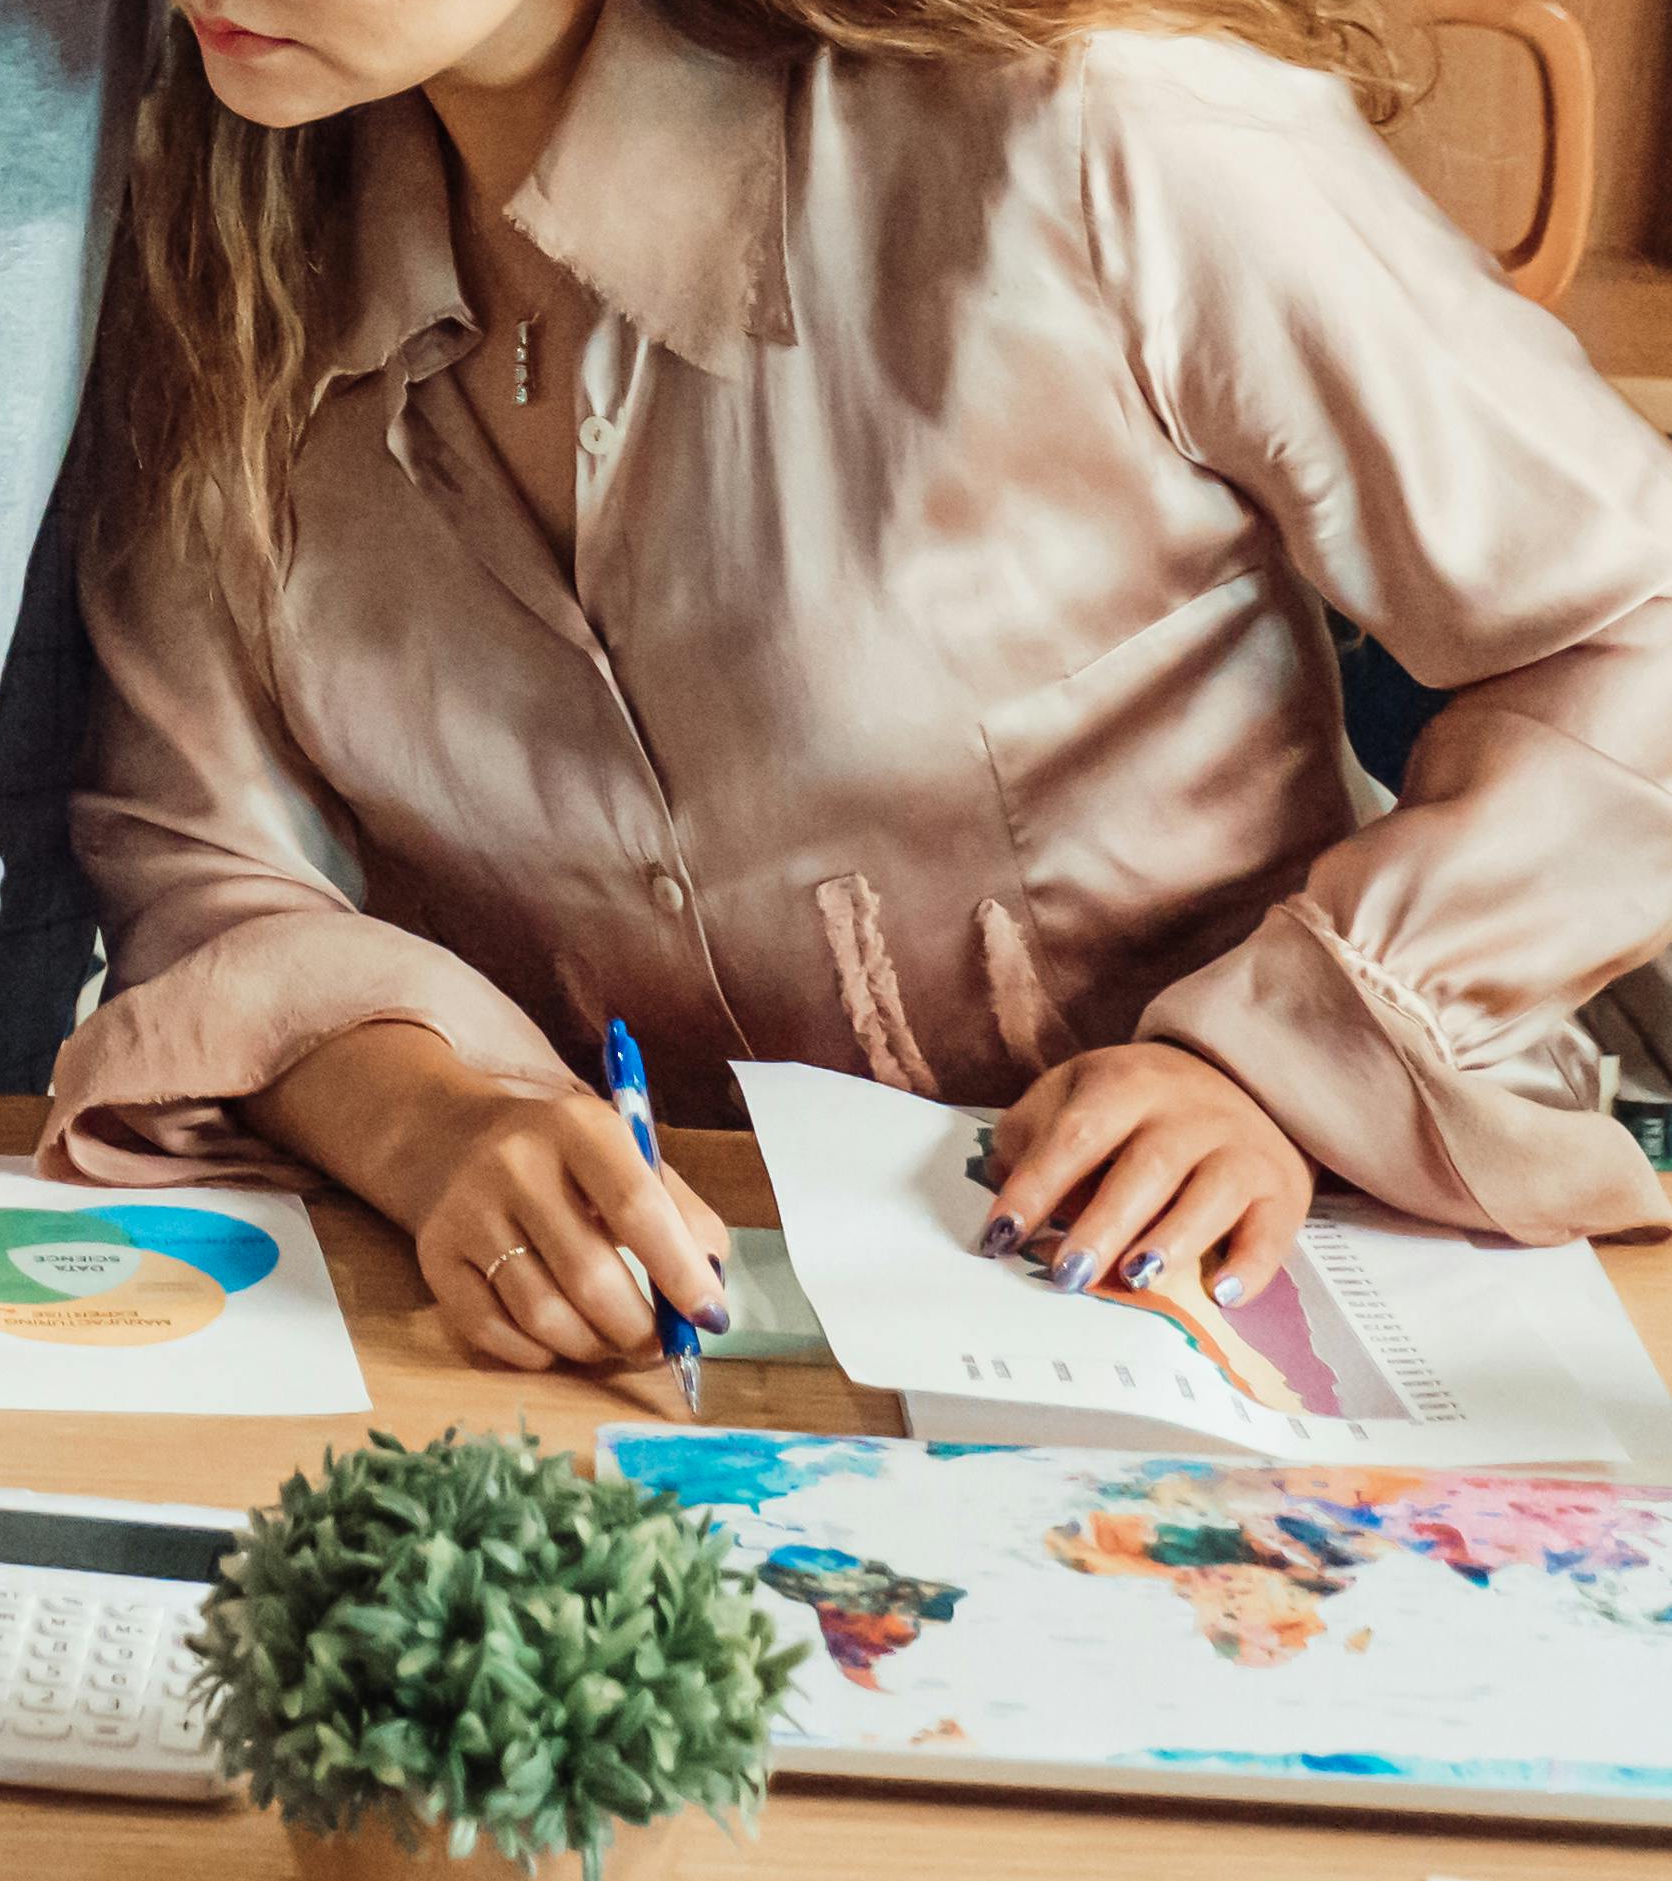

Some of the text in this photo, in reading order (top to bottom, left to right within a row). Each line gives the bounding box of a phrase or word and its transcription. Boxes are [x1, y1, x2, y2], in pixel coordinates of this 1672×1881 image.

[33, 1254, 121, 1264] SCIENCE
[54, 1264, 106, 1273] DATA
[31, 1310, 139, 1319] EXPERTISE
[3, 1318, 172, 1328] MANUFACTURING
